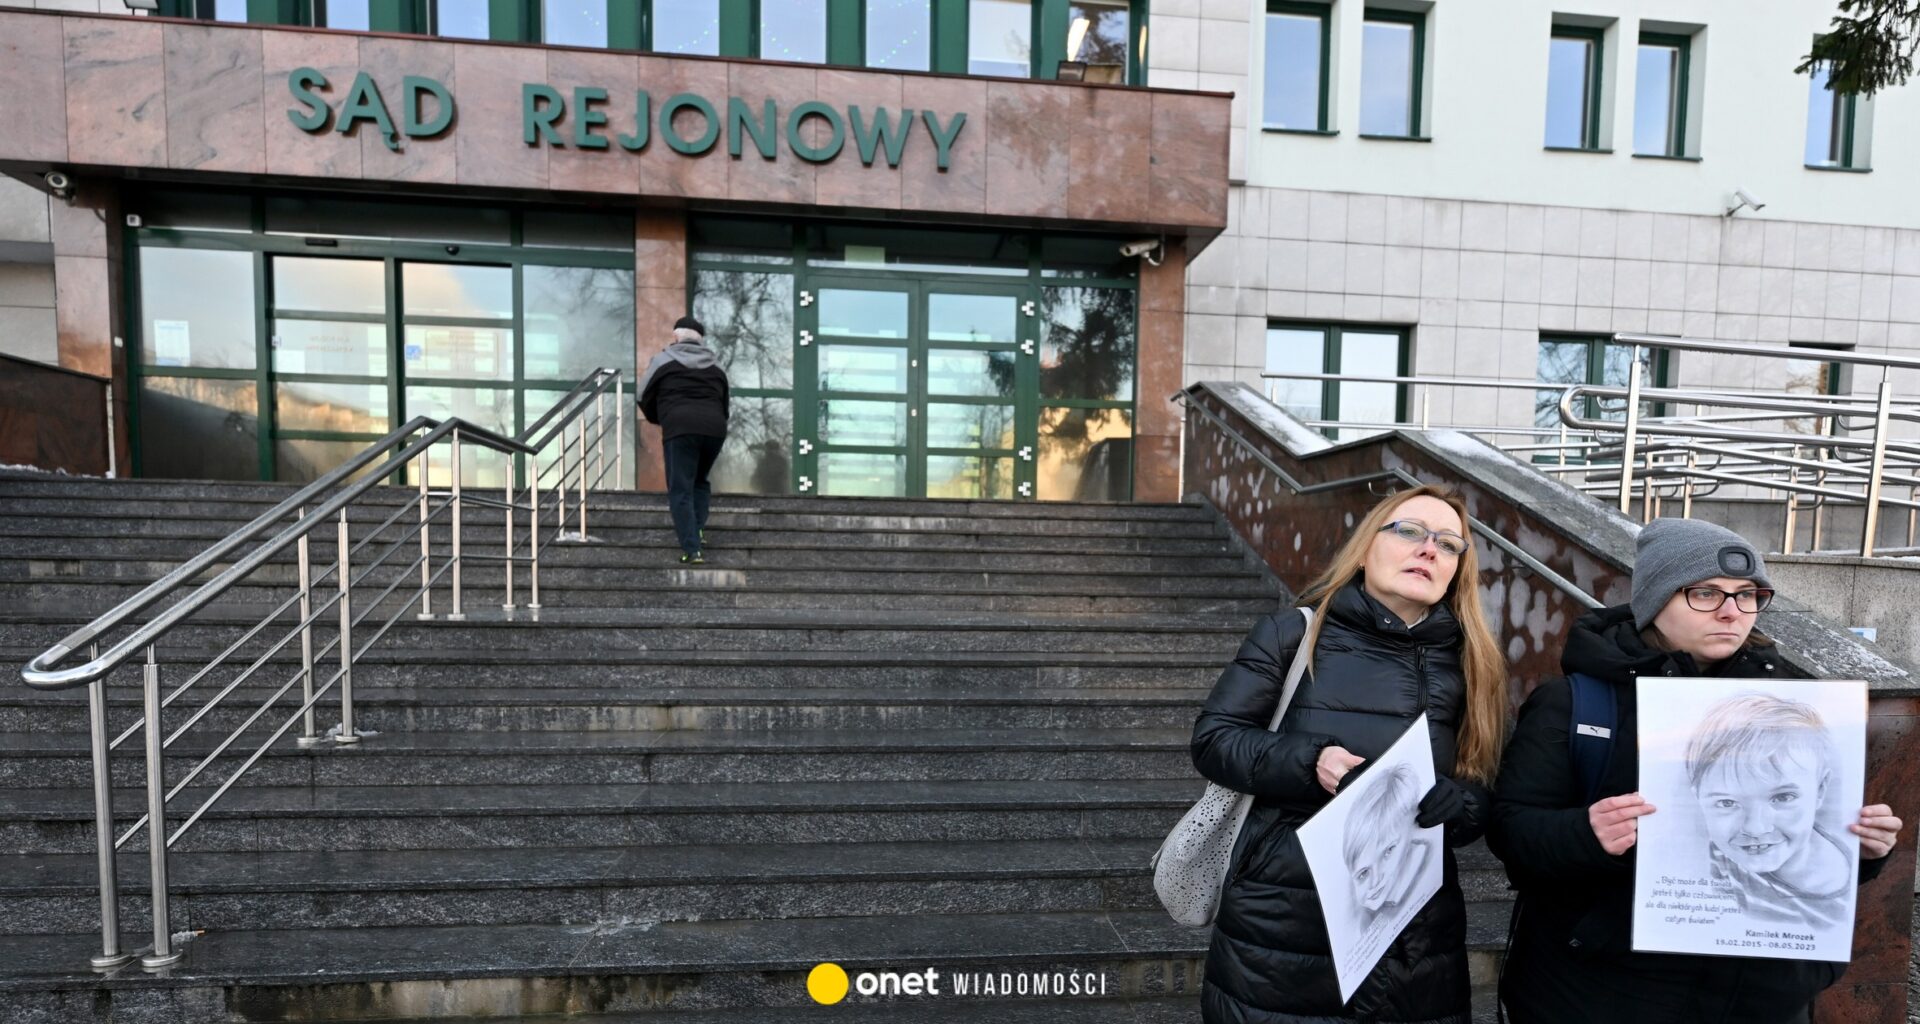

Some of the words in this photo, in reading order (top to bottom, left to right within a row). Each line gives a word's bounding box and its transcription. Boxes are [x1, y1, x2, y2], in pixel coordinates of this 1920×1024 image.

[287, 66, 455, 151] SĄD
[521, 82, 968, 172] REJONOWY
[1745, 929, 1779, 939] Kamilek
[1782, 932, 1815, 941] Mrozek
